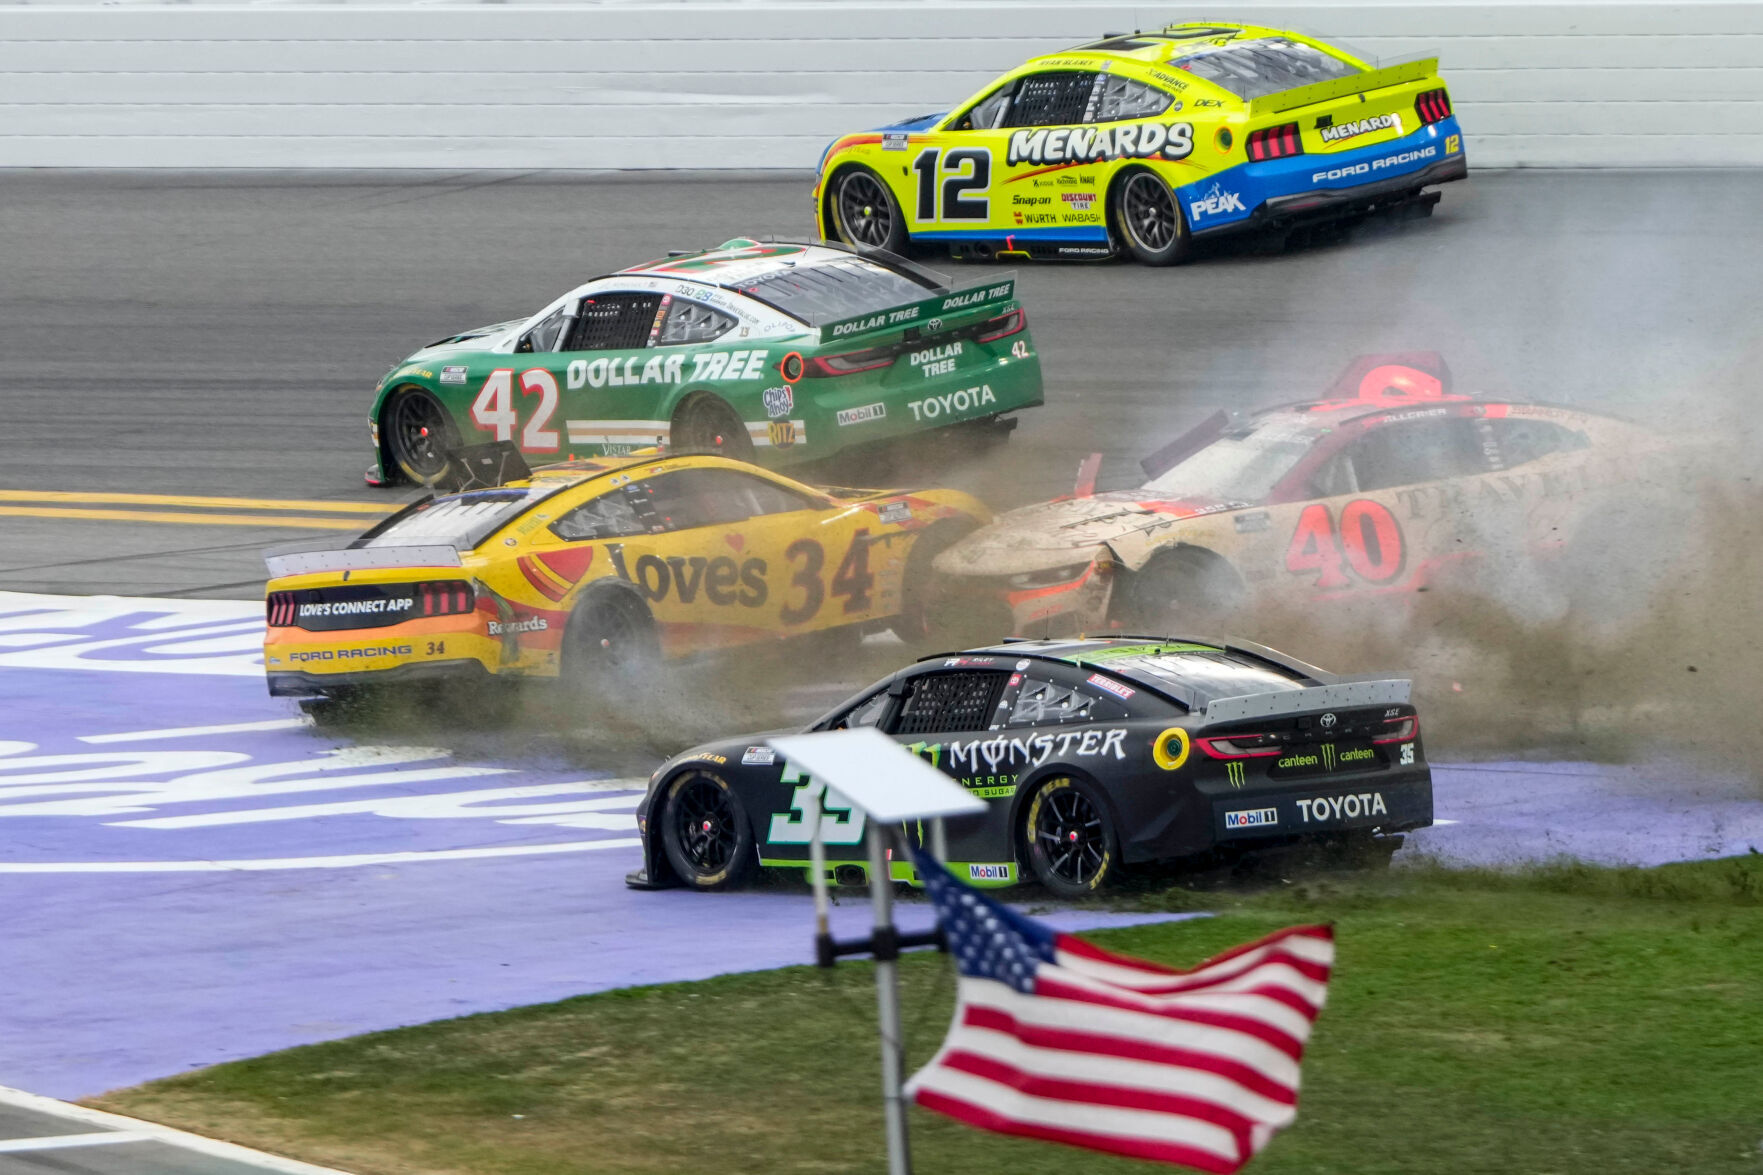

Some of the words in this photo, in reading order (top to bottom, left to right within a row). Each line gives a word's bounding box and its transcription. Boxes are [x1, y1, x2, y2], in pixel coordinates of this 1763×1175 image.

[1154, 71, 1189, 90] ADVANCE
[1194, 99, 1226, 107] DEX
[1007, 122, 1194, 167] MENARDS
[1444, 135, 1460, 155] 12
[1312, 162, 1370, 183] FORD
[1372, 146, 1437, 171] RACING
[913, 146, 992, 224] 12
[1011, 194, 1051, 206] Snap-on
[1061, 193, 1097, 202] DISCOUNT
[1072, 202, 1089, 210] TIRE
[1190, 192, 1247, 222] PEAK
[943, 289, 986, 311] DOLLAR
[988, 283, 1011, 299] TREE
[832, 315, 886, 336] DOLLAR
[889, 306, 920, 323] TREE
[911, 341, 963, 366] DOLLAR
[1011, 340, 1030, 359] 42
[567, 354, 685, 390] DOLLAR
[688, 350, 769, 382] TREE
[922, 358, 956, 378] TREE
[764, 388, 787, 406] Chips
[908, 384, 996, 421] TOYOTA
[469, 367, 561, 454] 42
[839, 406, 872, 424] Mobil
[872, 404, 884, 417] 1
[768, 422, 796, 445] RITZ
[1285, 499, 1406, 588] 40
[780, 528, 875, 627] 34
[300, 601, 331, 616] LOVE'S
[332, 599, 388, 615] CONNECT
[389, 598, 413, 612] APP
[290, 651, 335, 662] FORD
[338, 645, 412, 659] RACING
[425, 641, 445, 655] 34
[1384, 708, 1400, 718] XSE
[1278, 753, 1318, 768] canteen
[1340, 747, 1375, 761] canteen
[1400, 743, 1415, 765] 35
[955, 774, 1019, 786] NERGY
[984, 787, 1017, 797] SUGAR
[1296, 792, 1388, 822] TOYOTA
[1227, 811, 1263, 827] Mobil
[1264, 809, 1276, 823] 1
[971, 864, 998, 879] Mobil
[998, 865, 1008, 878] 1
